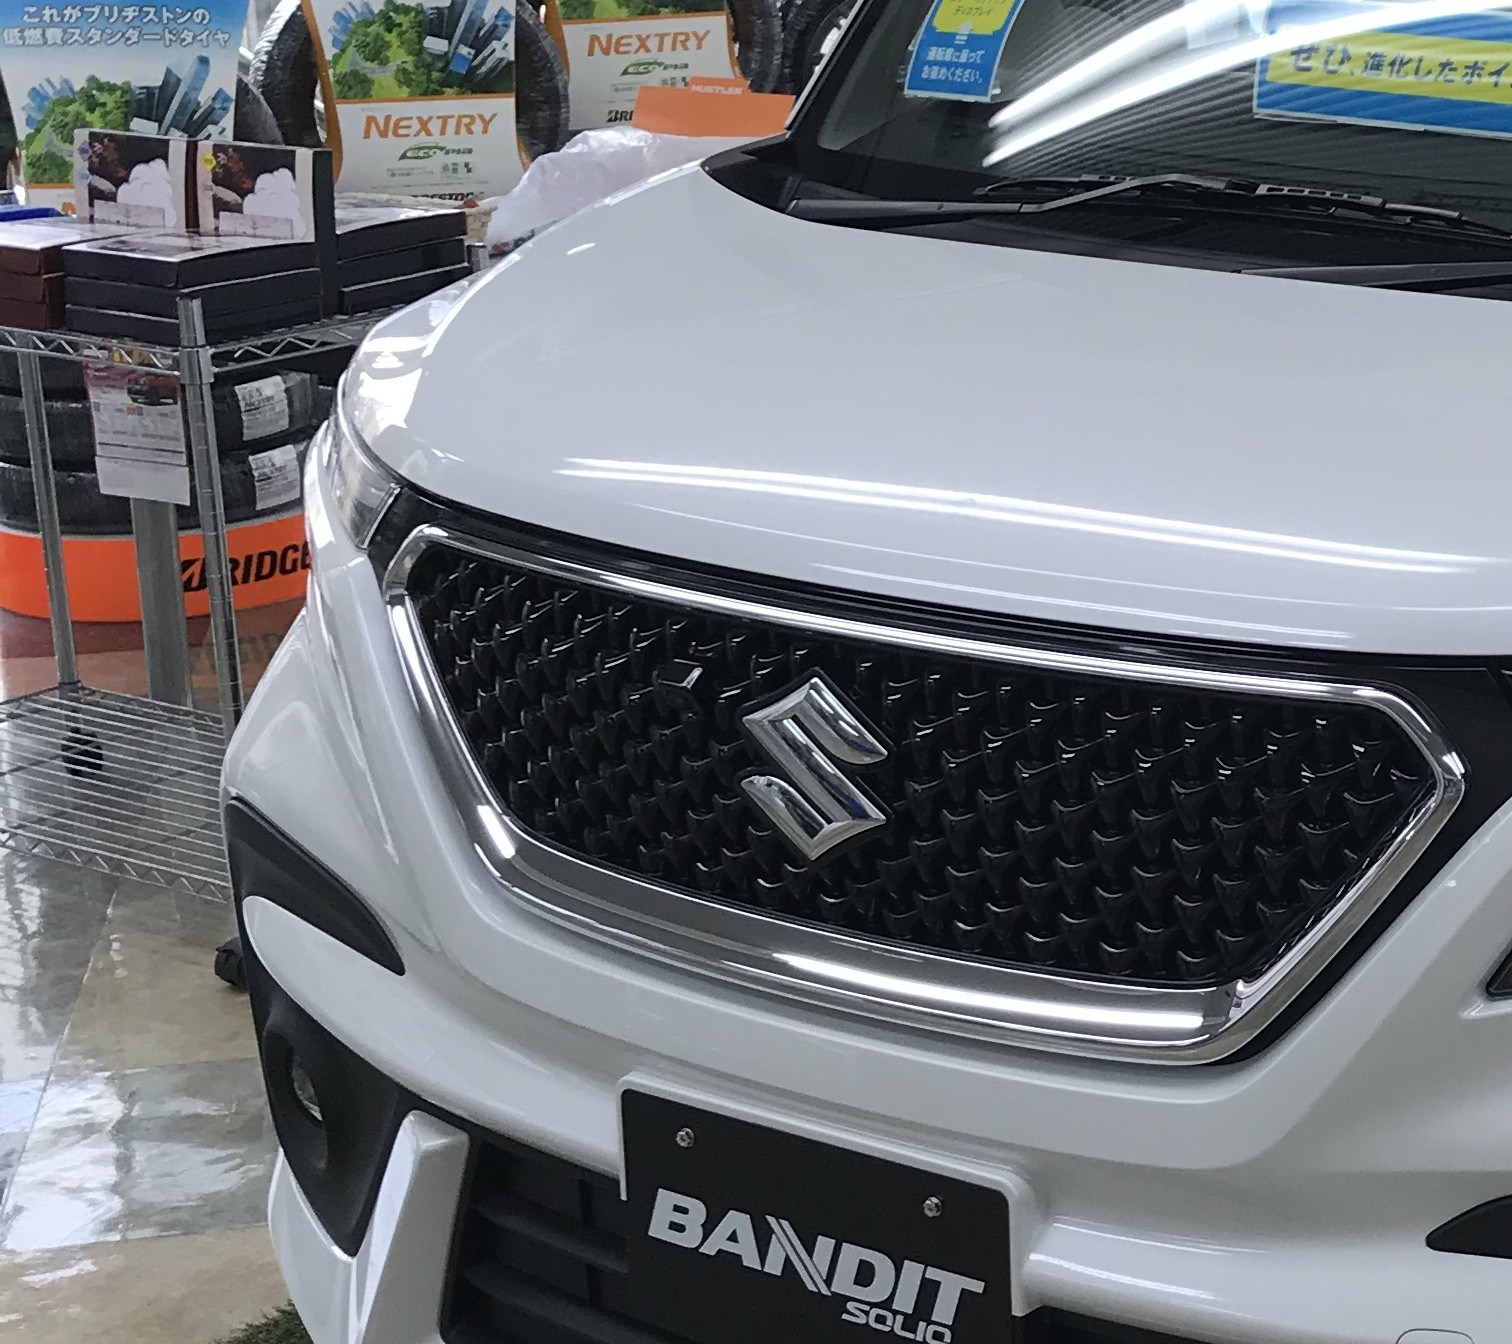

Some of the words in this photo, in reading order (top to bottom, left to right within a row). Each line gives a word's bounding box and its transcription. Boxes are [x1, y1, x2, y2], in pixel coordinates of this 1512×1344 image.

[2, 27, 231, 47] 低燃費スタンダードタイヤ
[587, 30, 711, 57] NEXTRY
[363, 113, 498, 140] NEXTRY
[648, 1187, 985, 1326] BANDIT
